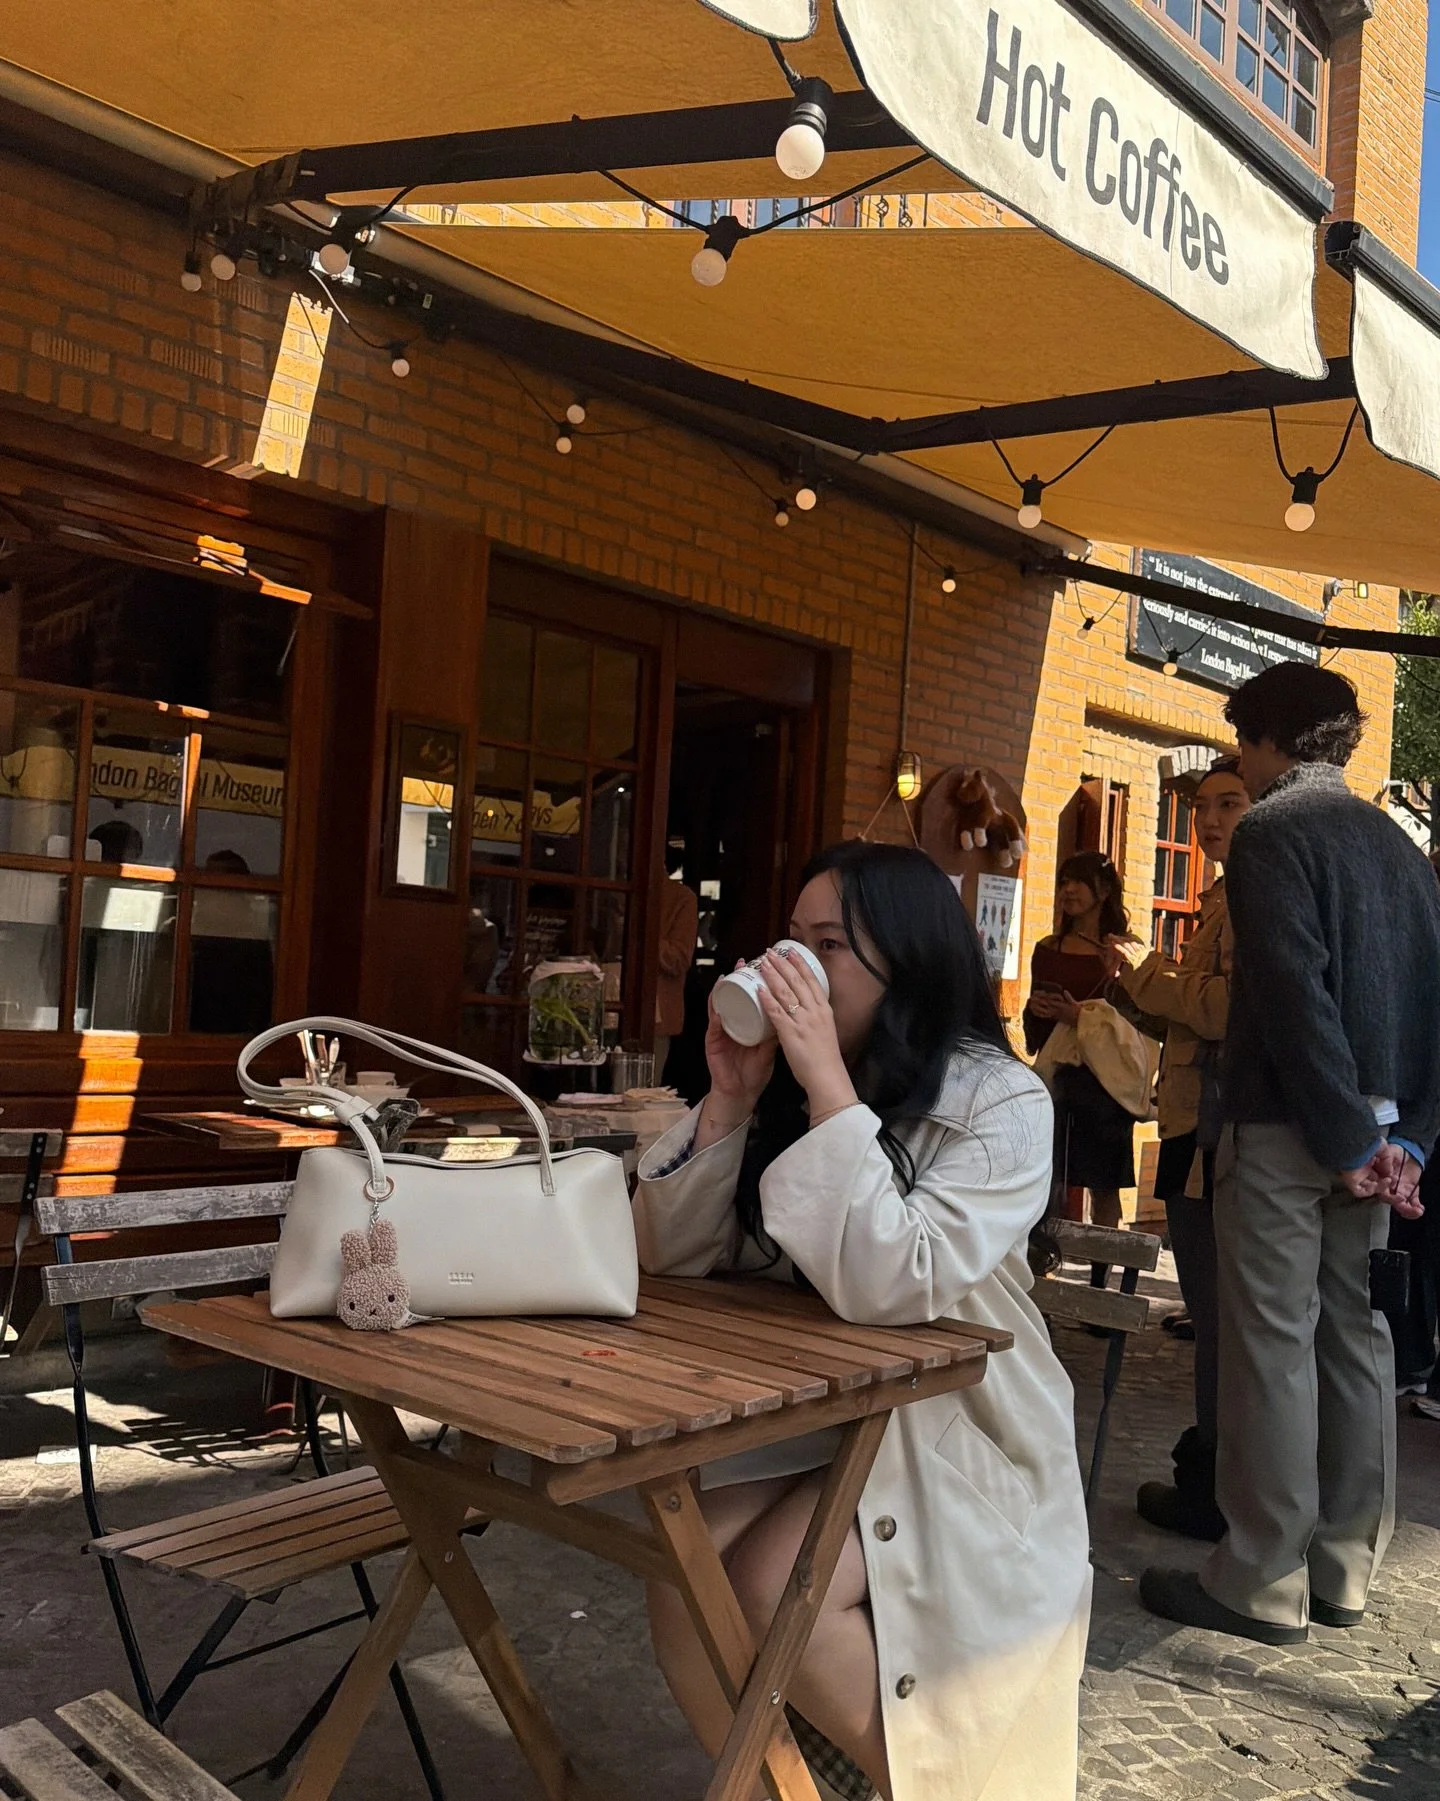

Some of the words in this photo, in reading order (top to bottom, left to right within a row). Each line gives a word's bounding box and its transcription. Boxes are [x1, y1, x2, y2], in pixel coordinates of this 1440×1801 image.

[976, 8, 1071, 182] Hot
[1085, 96, 1230, 286] Coffee
[1163, 561, 1170, 577] is
[1170, 568, 1183, 582] not
[1183, 570, 1196, 588] just
[1197, 577, 1208, 593] the
[1174, 610, 1188, 625] and
[1217, 625, 1230, 642] into
[1230, 634, 1250, 651] action
[1201, 647, 1225, 672] London
[1225, 657, 1242, 681] Bagel
[91, 760, 138, 789] ndon
[143, 766, 208, 799] Bagl
[472, 811, 500, 830] pen
